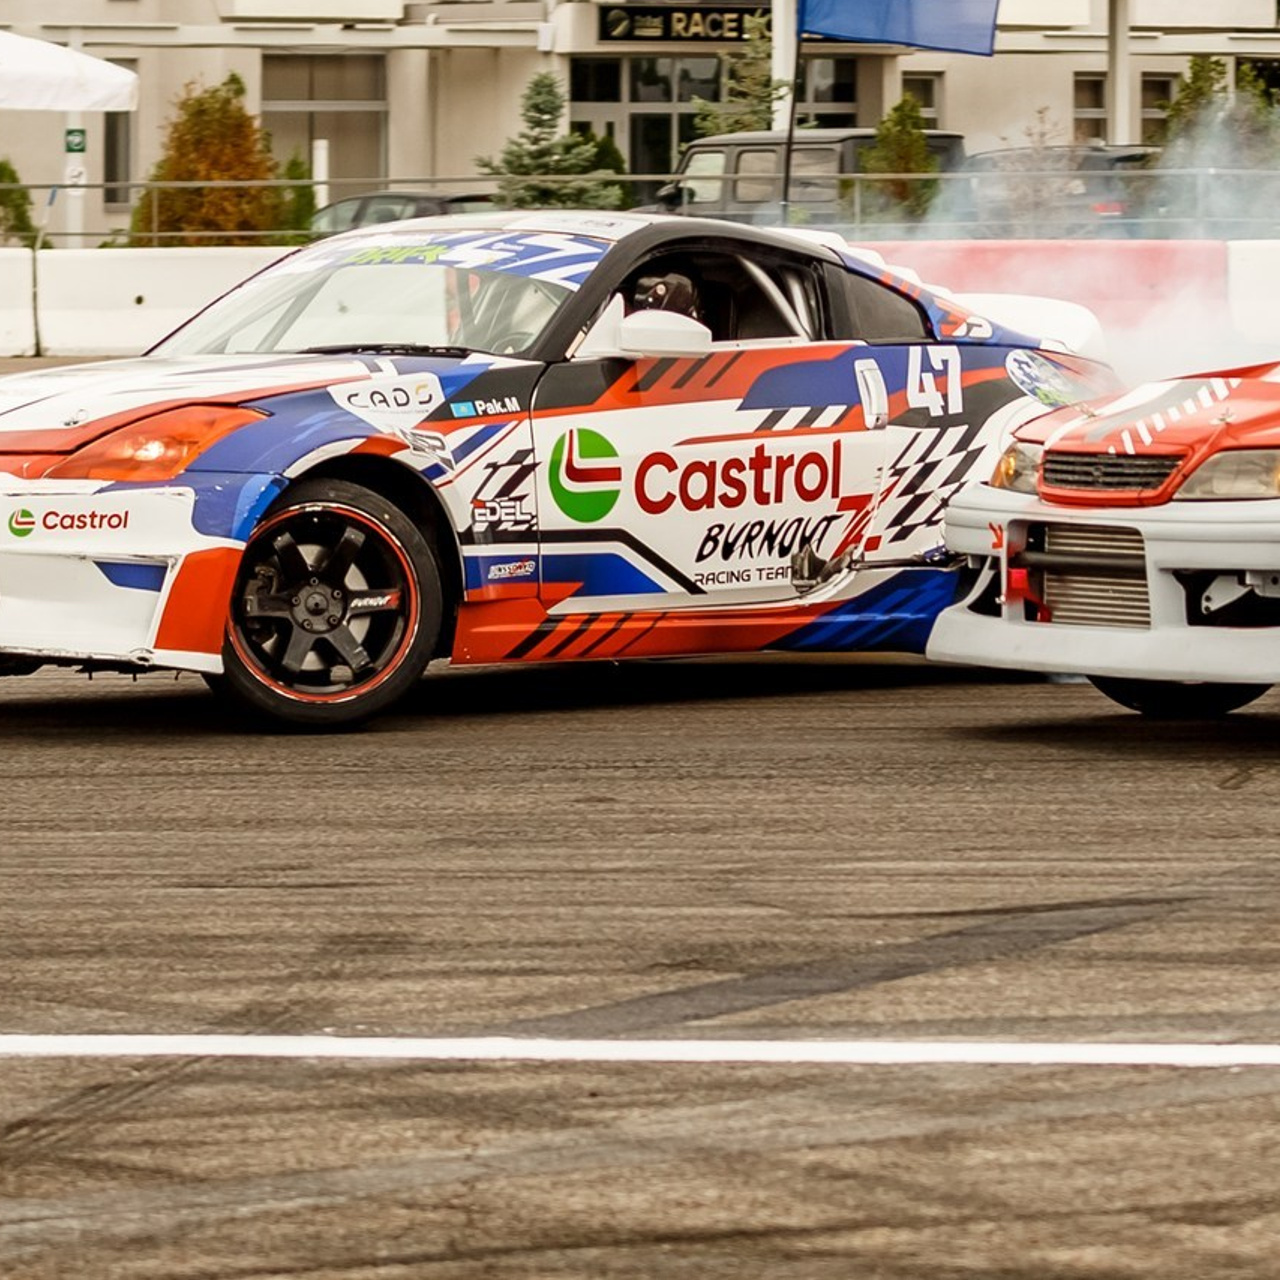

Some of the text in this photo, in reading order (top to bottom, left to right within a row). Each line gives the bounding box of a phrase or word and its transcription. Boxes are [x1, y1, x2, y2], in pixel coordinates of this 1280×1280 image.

[671, 11, 739, 38] RACE
[906, 345, 963, 418] 47
[474, 396, 521, 416] Pak.M
[635, 439, 842, 515] Castrol
[42, 510, 129, 530] Castrol
[695, 514, 844, 563] BURNOUT
[694, 568, 750, 586] RACING
